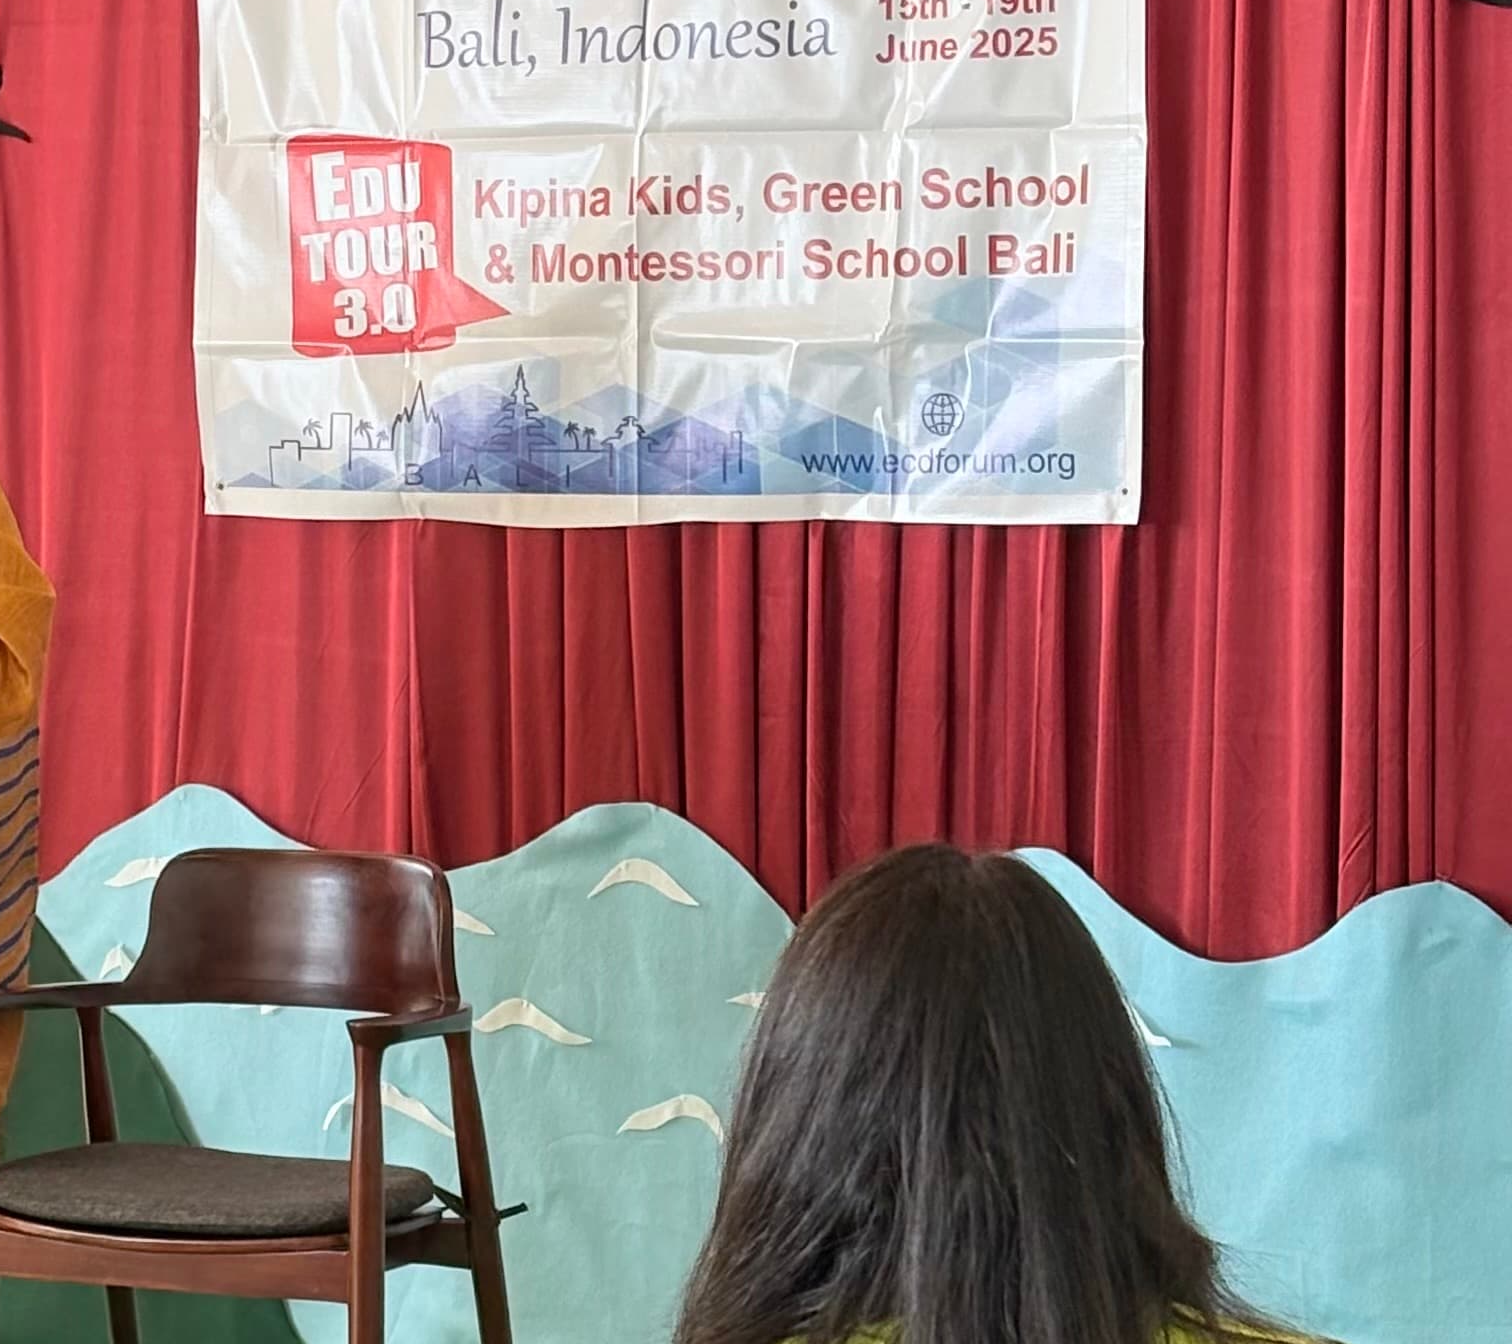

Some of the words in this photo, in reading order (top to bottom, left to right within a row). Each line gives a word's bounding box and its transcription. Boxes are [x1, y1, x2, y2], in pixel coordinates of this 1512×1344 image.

[417, 0, 538, 77] Bali,
[875, 33, 958, 64] June
[969, 26, 1058, 59] 2025
[474, 177, 611, 228] Kipina
[628, 174, 745, 223] Kids,
[763, 171, 902, 214] Green
[920, 163, 1090, 210] School
[300, 220, 439, 283] TOUR
[484, 243, 515, 284] &
[532, 240, 785, 283] Montessori
[802, 235, 967, 280] School
[988, 231, 1075, 276] Bali
[333, 282, 417, 338] 3.0
[802, 447, 1076, 480] www.ecdforum.org
